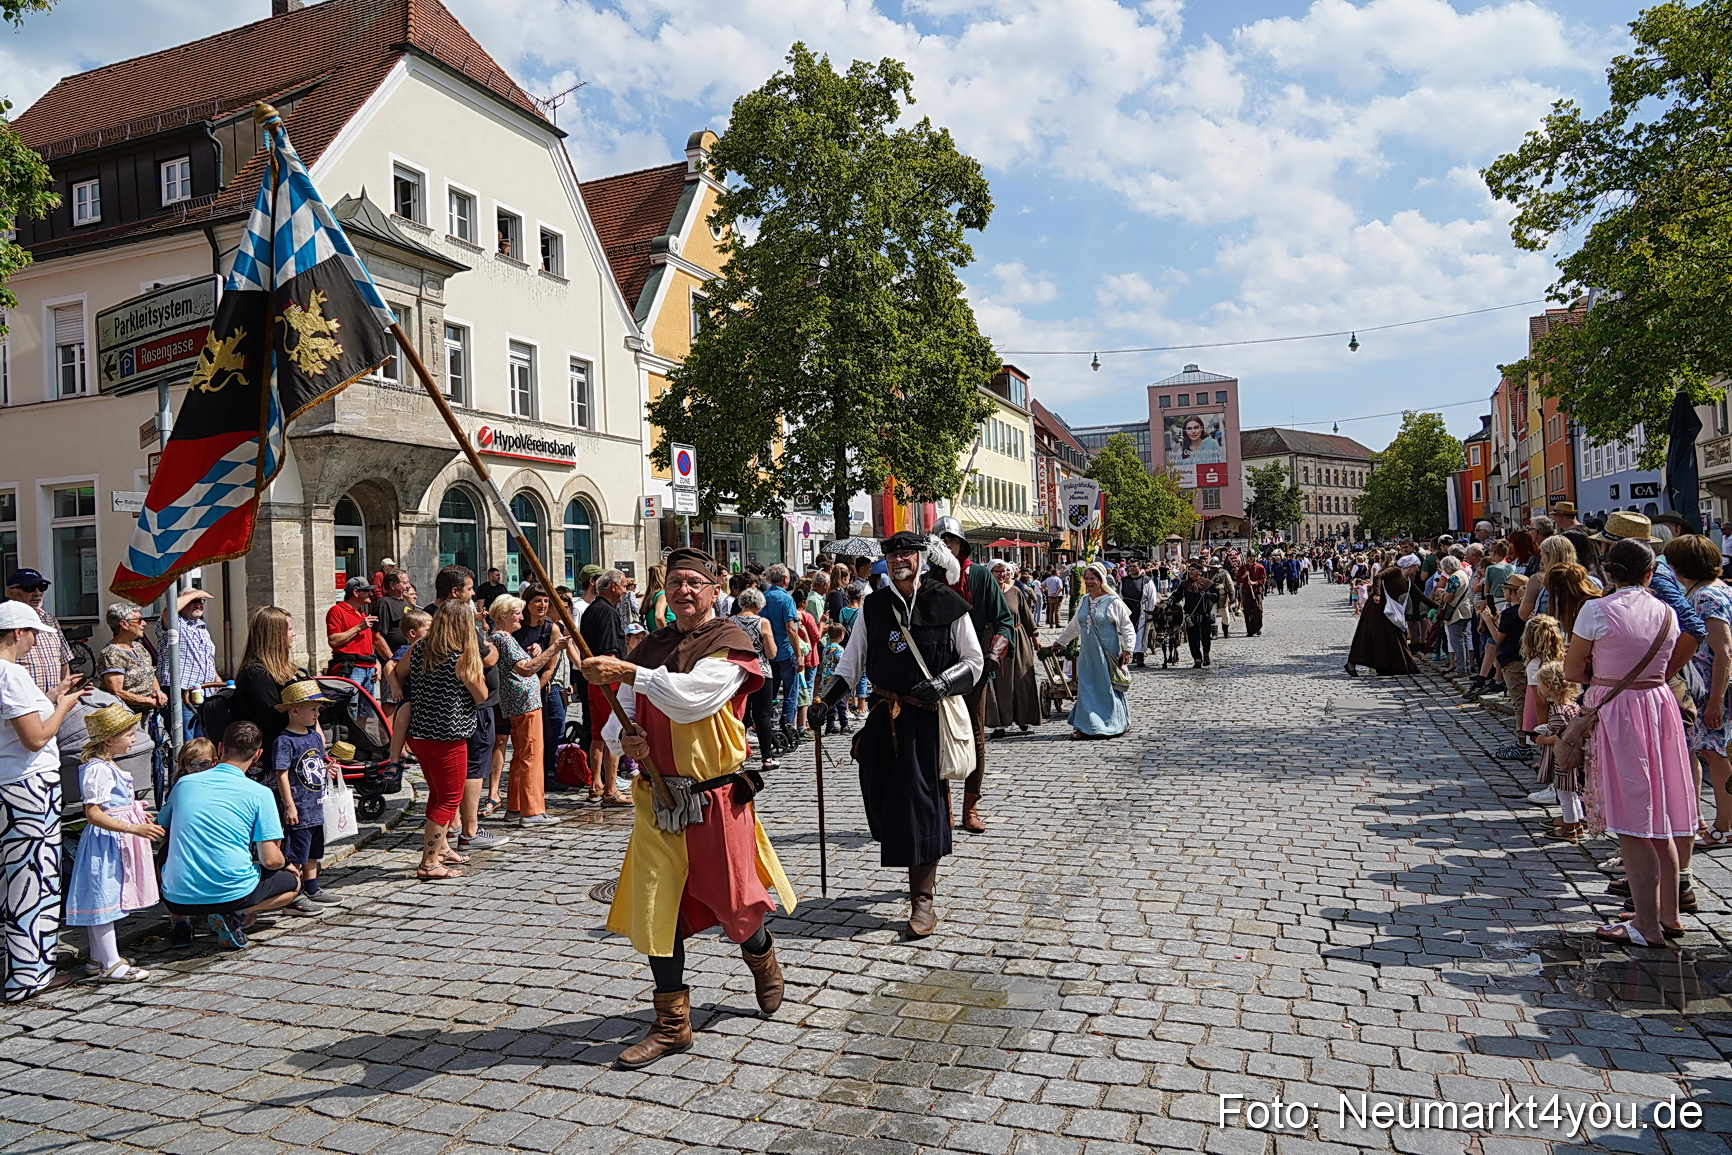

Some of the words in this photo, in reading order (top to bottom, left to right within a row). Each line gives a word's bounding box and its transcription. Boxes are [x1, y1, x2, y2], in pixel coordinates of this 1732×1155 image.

[114, 298, 192, 338] Parkleitsystem
[124, 355, 131, 375] P
[141, 337, 194, 365] Rosengasse
[494, 429, 576, 457] HypoVereinsbank
[680, 477, 691, 485] ZONE
